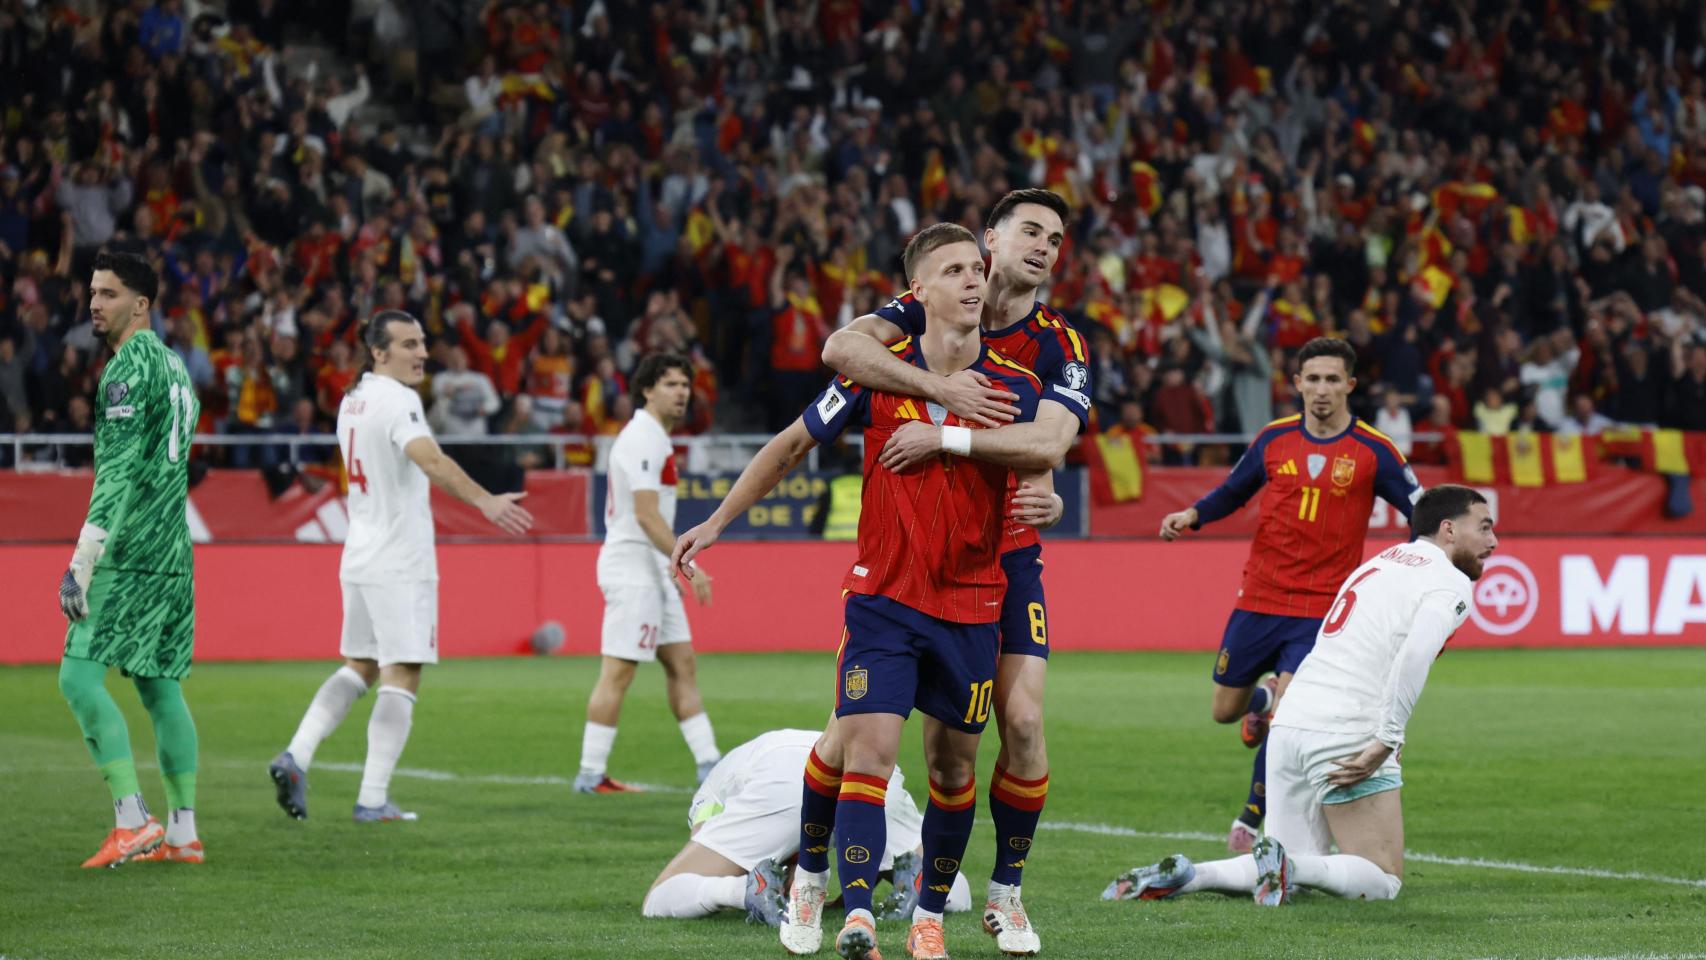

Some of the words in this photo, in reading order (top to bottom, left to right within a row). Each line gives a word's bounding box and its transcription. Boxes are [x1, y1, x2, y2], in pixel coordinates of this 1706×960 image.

[347, 427, 367, 495] 4
[748, 505, 791, 527] DE
[1298, 486, 1320, 522] 11
[1323, 567, 1380, 637] 6
[1559, 555, 1706, 635] MA
[1027, 602, 1047, 646] 8
[964, 679, 993, 724] 10
